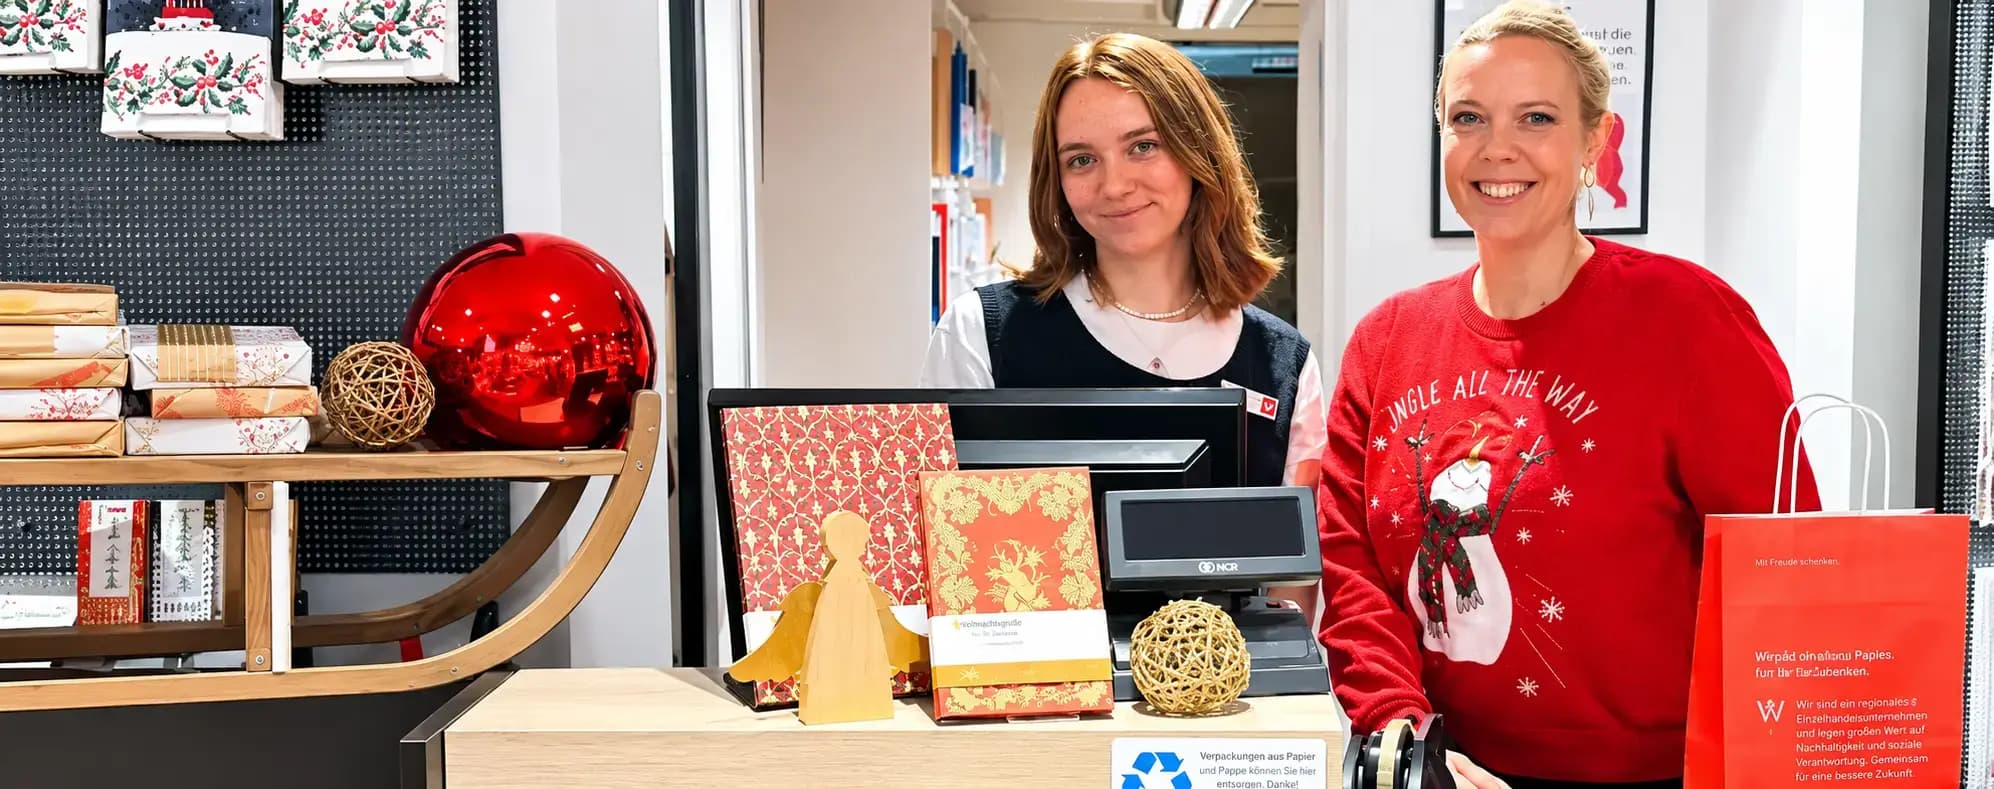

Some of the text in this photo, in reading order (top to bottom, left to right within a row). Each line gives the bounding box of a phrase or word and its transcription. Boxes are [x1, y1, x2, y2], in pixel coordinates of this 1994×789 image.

[1611, 27, 1632, 40] die
[1453, 370, 1489, 400] ALL
[1501, 369, 1544, 398] THE
[1544, 375, 1599, 424] WAY
[1216, 562, 1239, 572] NCR
[1796, 700, 1813, 709] Wir
[1816, 698, 1837, 709] sind
[1839, 699, 1856, 708] ein
[1857, 698, 1909, 709] regionales
[1796, 712, 1928, 724] Einzelhandelsunternehmen
[1796, 725, 1926, 739] und legen großen Wert auf
[1796, 740, 1922, 753] Nachhaltigkeit und soziale
[1199, 751, 1316, 762] Verpackungen aus Papier
[1870, 755, 1928, 765] Gemeinsam
[1199, 766, 1316, 776] und Pappe können Sie hier
[1811, 771, 1832, 780] eine
[1835, 770, 1873, 780] bessere
